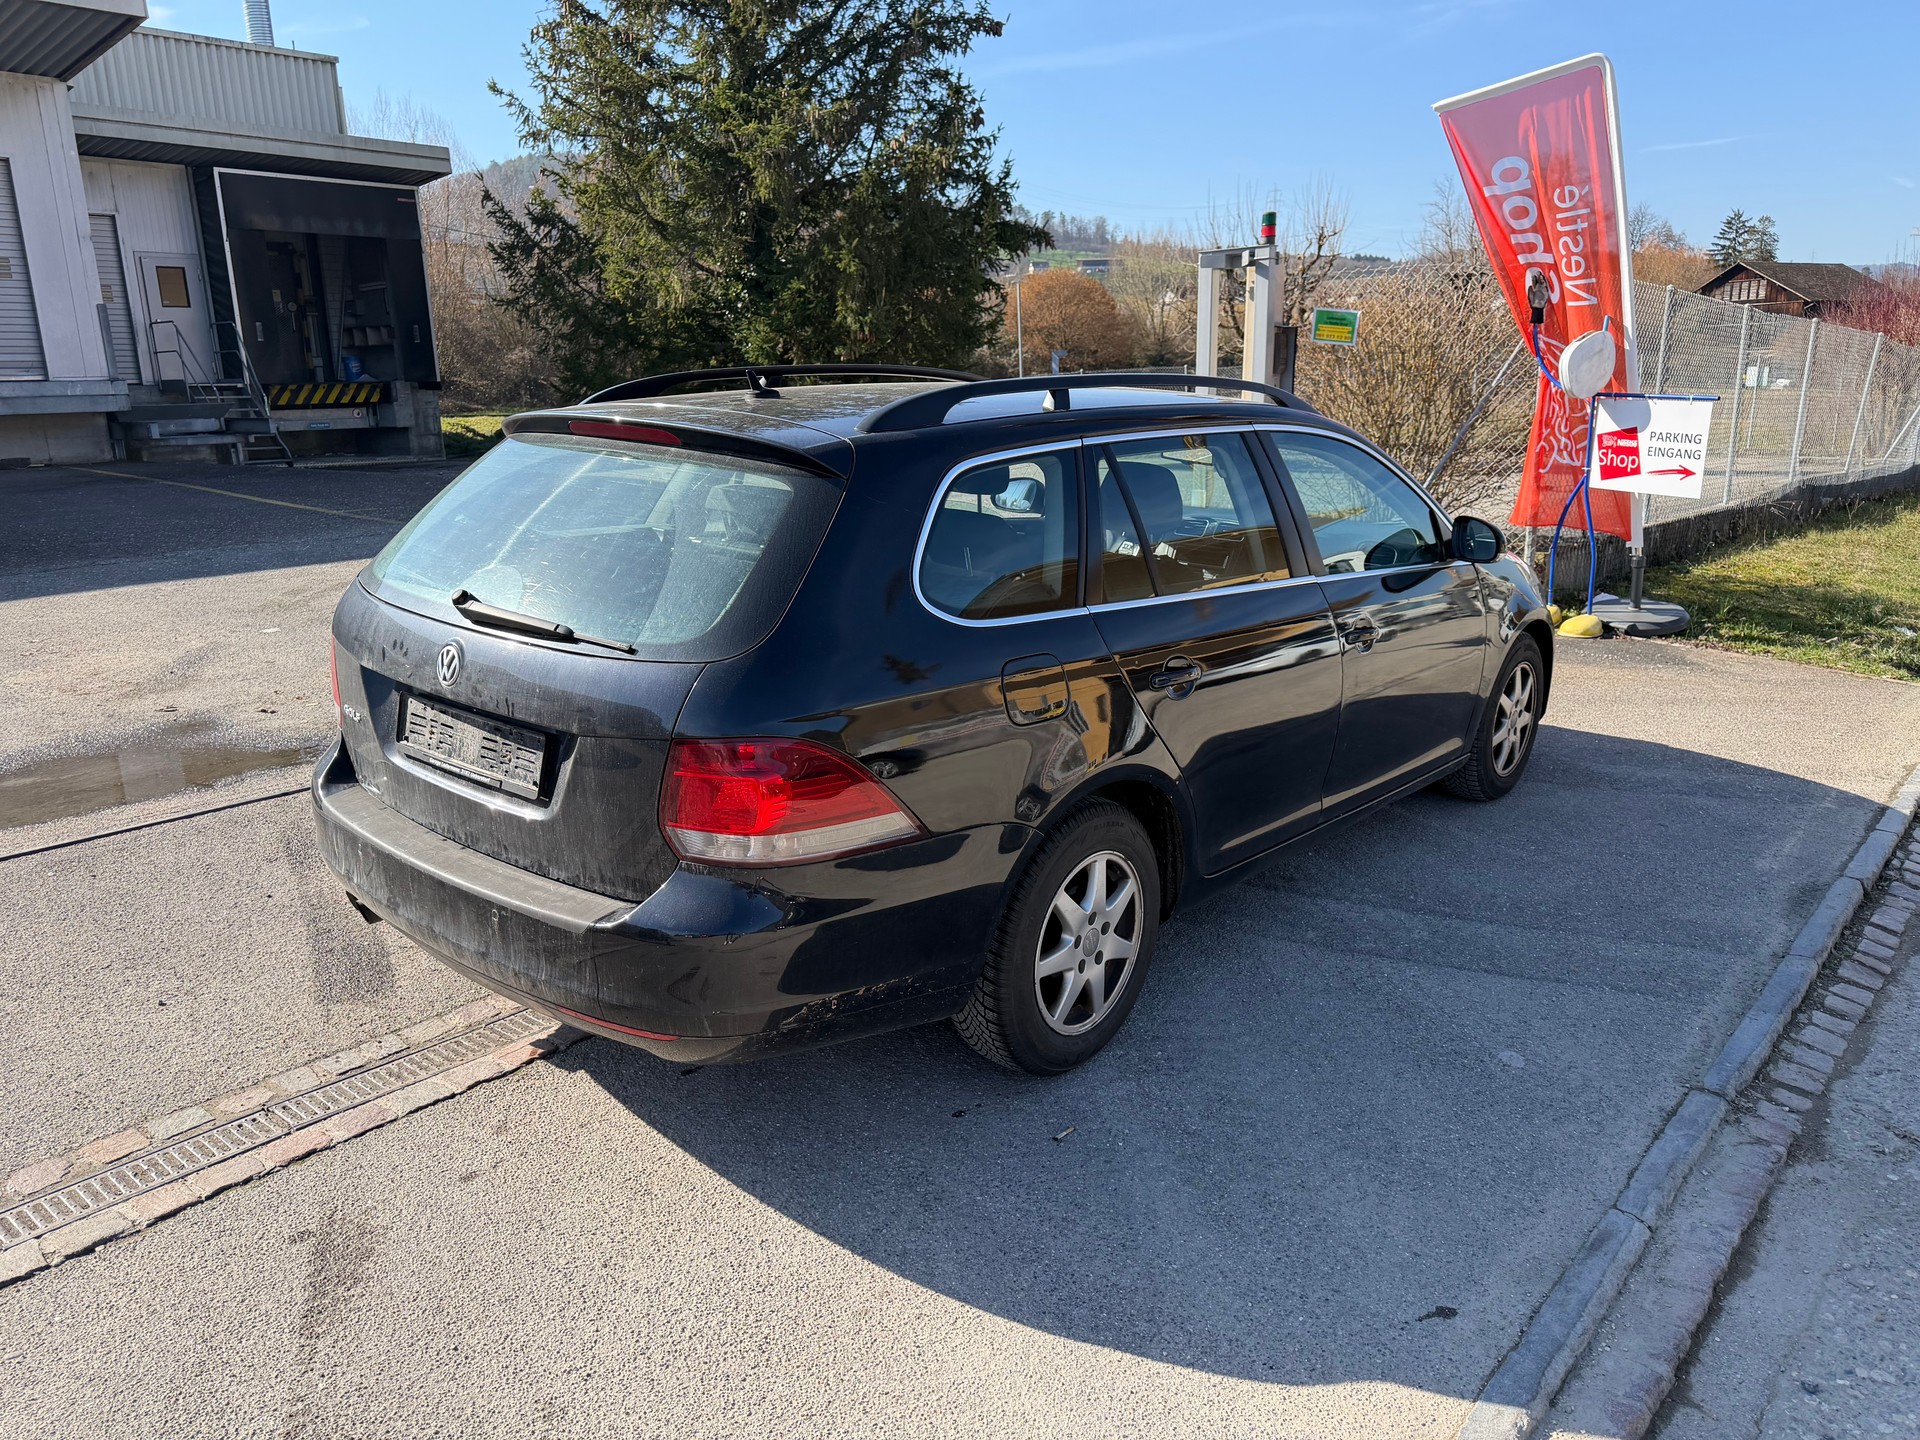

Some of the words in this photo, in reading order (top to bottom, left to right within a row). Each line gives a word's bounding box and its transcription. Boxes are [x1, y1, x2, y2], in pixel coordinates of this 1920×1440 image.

[1649, 431, 1703, 444] PARKING
[1598, 448, 1639, 472] Shop
[1647, 446, 1702, 460] EINGANG
[343, 703, 361, 722] GOLF
